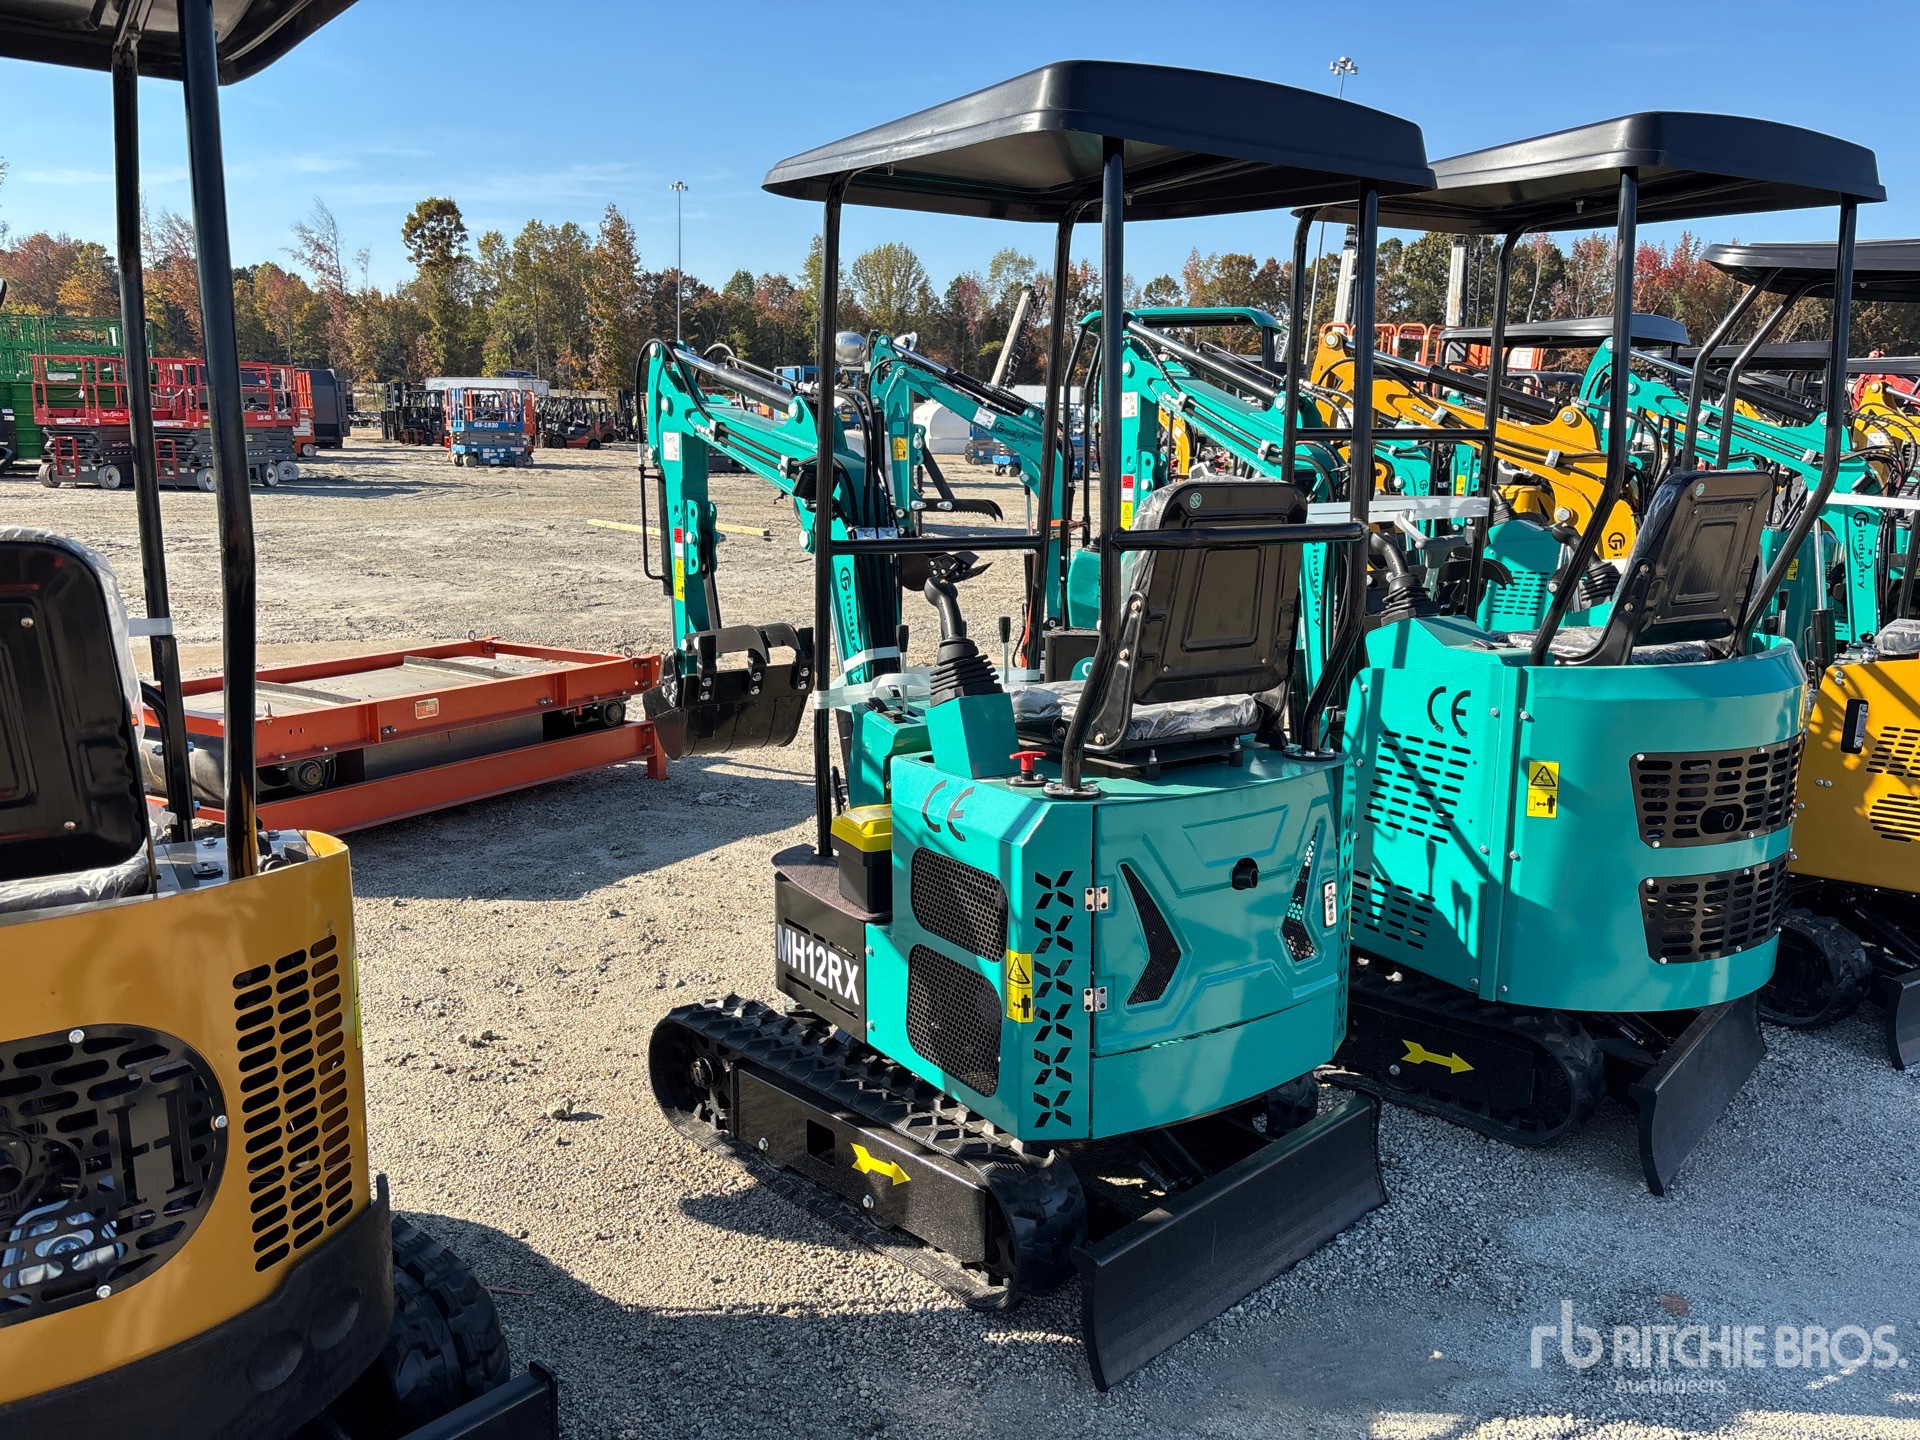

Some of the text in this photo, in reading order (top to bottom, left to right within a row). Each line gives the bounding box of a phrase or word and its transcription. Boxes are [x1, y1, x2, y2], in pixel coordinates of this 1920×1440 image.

[1426, 685, 1473, 738] CE
[922, 779, 976, 842] CE
[777, 924, 860, 1005] MH12RX
